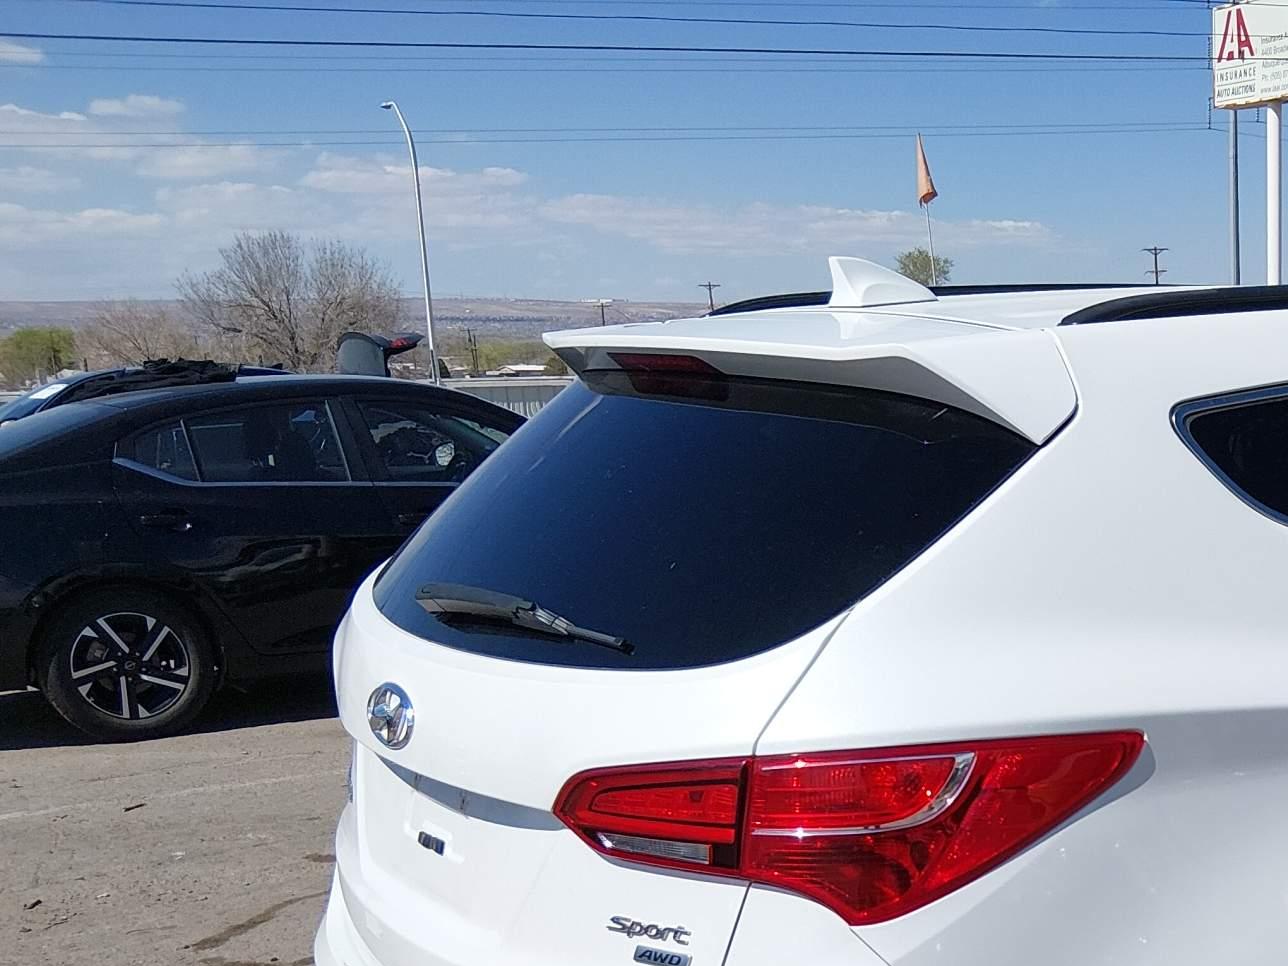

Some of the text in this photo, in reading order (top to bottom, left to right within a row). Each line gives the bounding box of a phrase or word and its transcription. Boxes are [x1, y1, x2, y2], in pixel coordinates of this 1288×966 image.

[1216, 66, 1256, 82] INSURANCE
[1217, 82, 1256, 98] AUTO AUCTIONS
[606, 915, 691, 946] Sport
[637, 949, 682, 966] AWD
